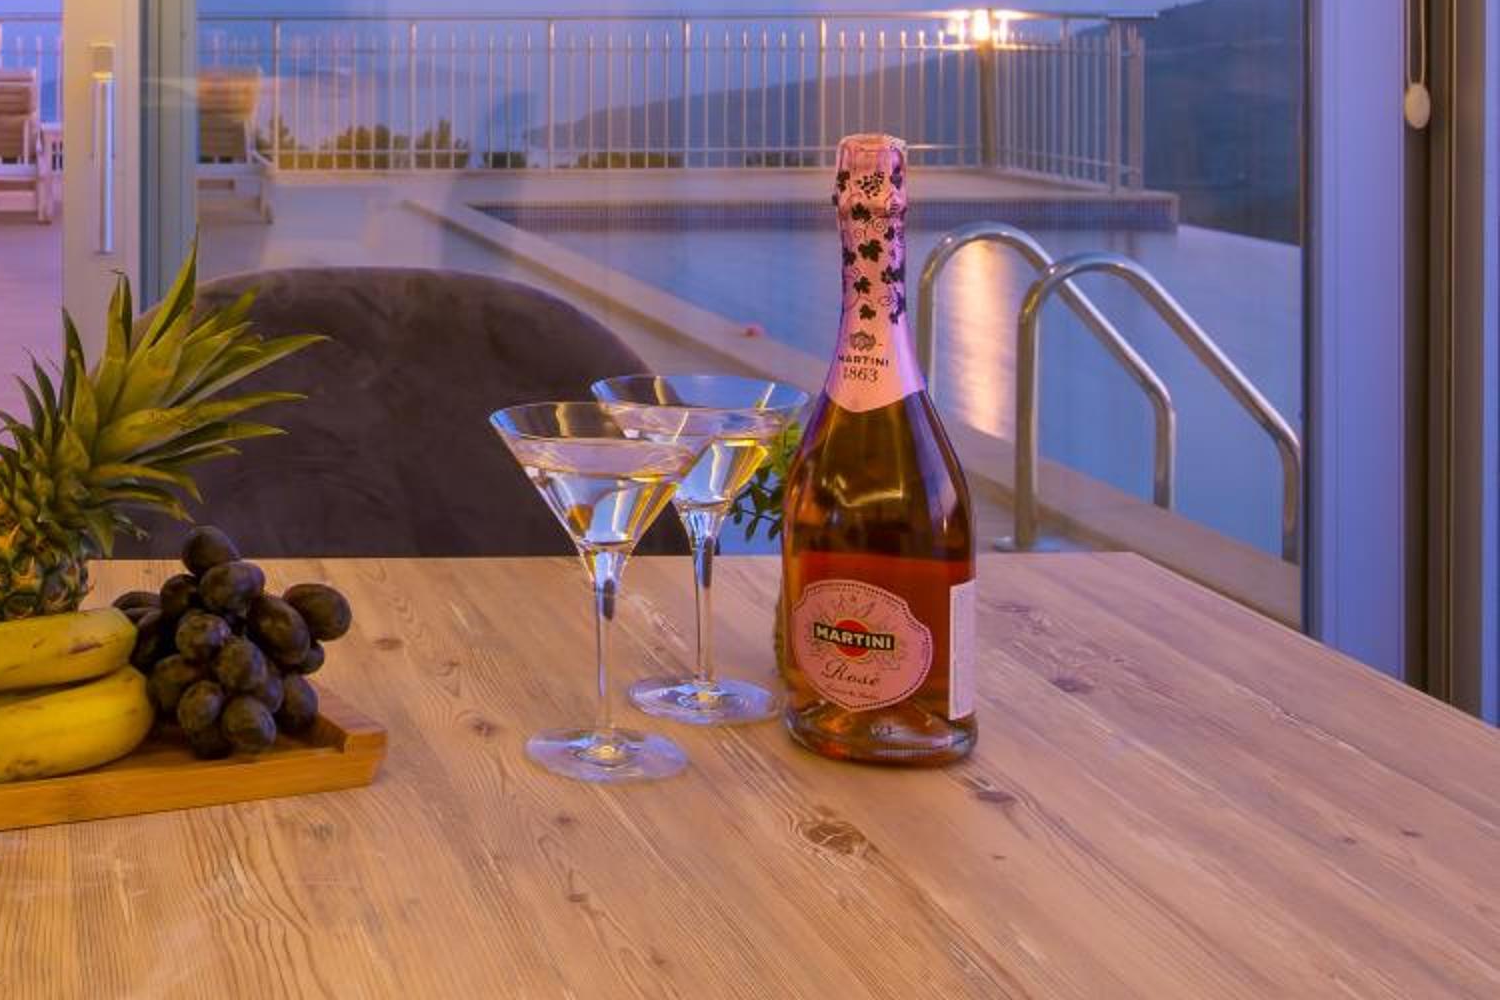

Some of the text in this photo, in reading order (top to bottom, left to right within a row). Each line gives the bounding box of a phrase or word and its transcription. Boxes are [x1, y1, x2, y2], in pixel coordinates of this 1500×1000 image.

[837, 355, 889, 367] MARTINI
[843, 366, 878, 382] 1863
[815, 625, 892, 649] MARTINI
